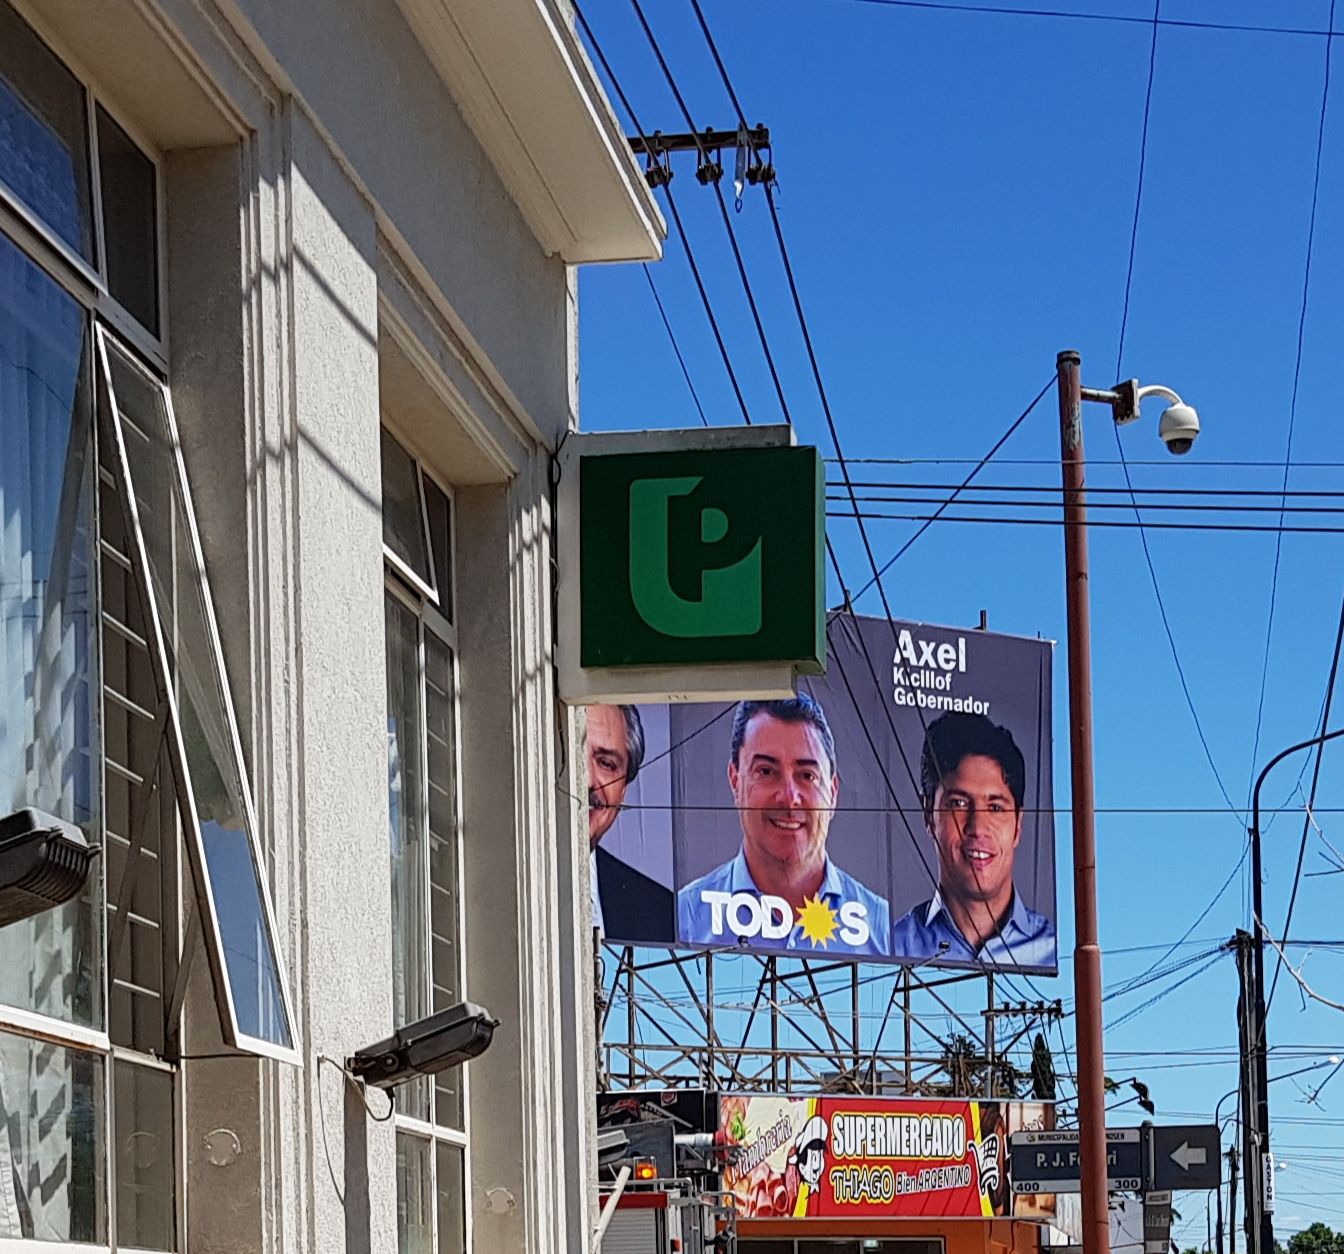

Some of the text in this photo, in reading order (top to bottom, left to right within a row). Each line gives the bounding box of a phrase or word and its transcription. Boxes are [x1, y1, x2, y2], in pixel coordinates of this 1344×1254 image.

[893, 629, 967, 673] Axel
[893, 687, 990, 716] Gobernador
[832, 1113, 965, 1158] SUPERMERCADO
[1037, 1132, 1080, 1142] MUNICIPALIDA
[1036, 1152, 1048, 1168] P.
[1052, 1152, 1065, 1168] J.
[831, 1165, 971, 1201] THIAGO Bien ARGENTINO
[1016, 1179, 1139, 1192] 400 300
